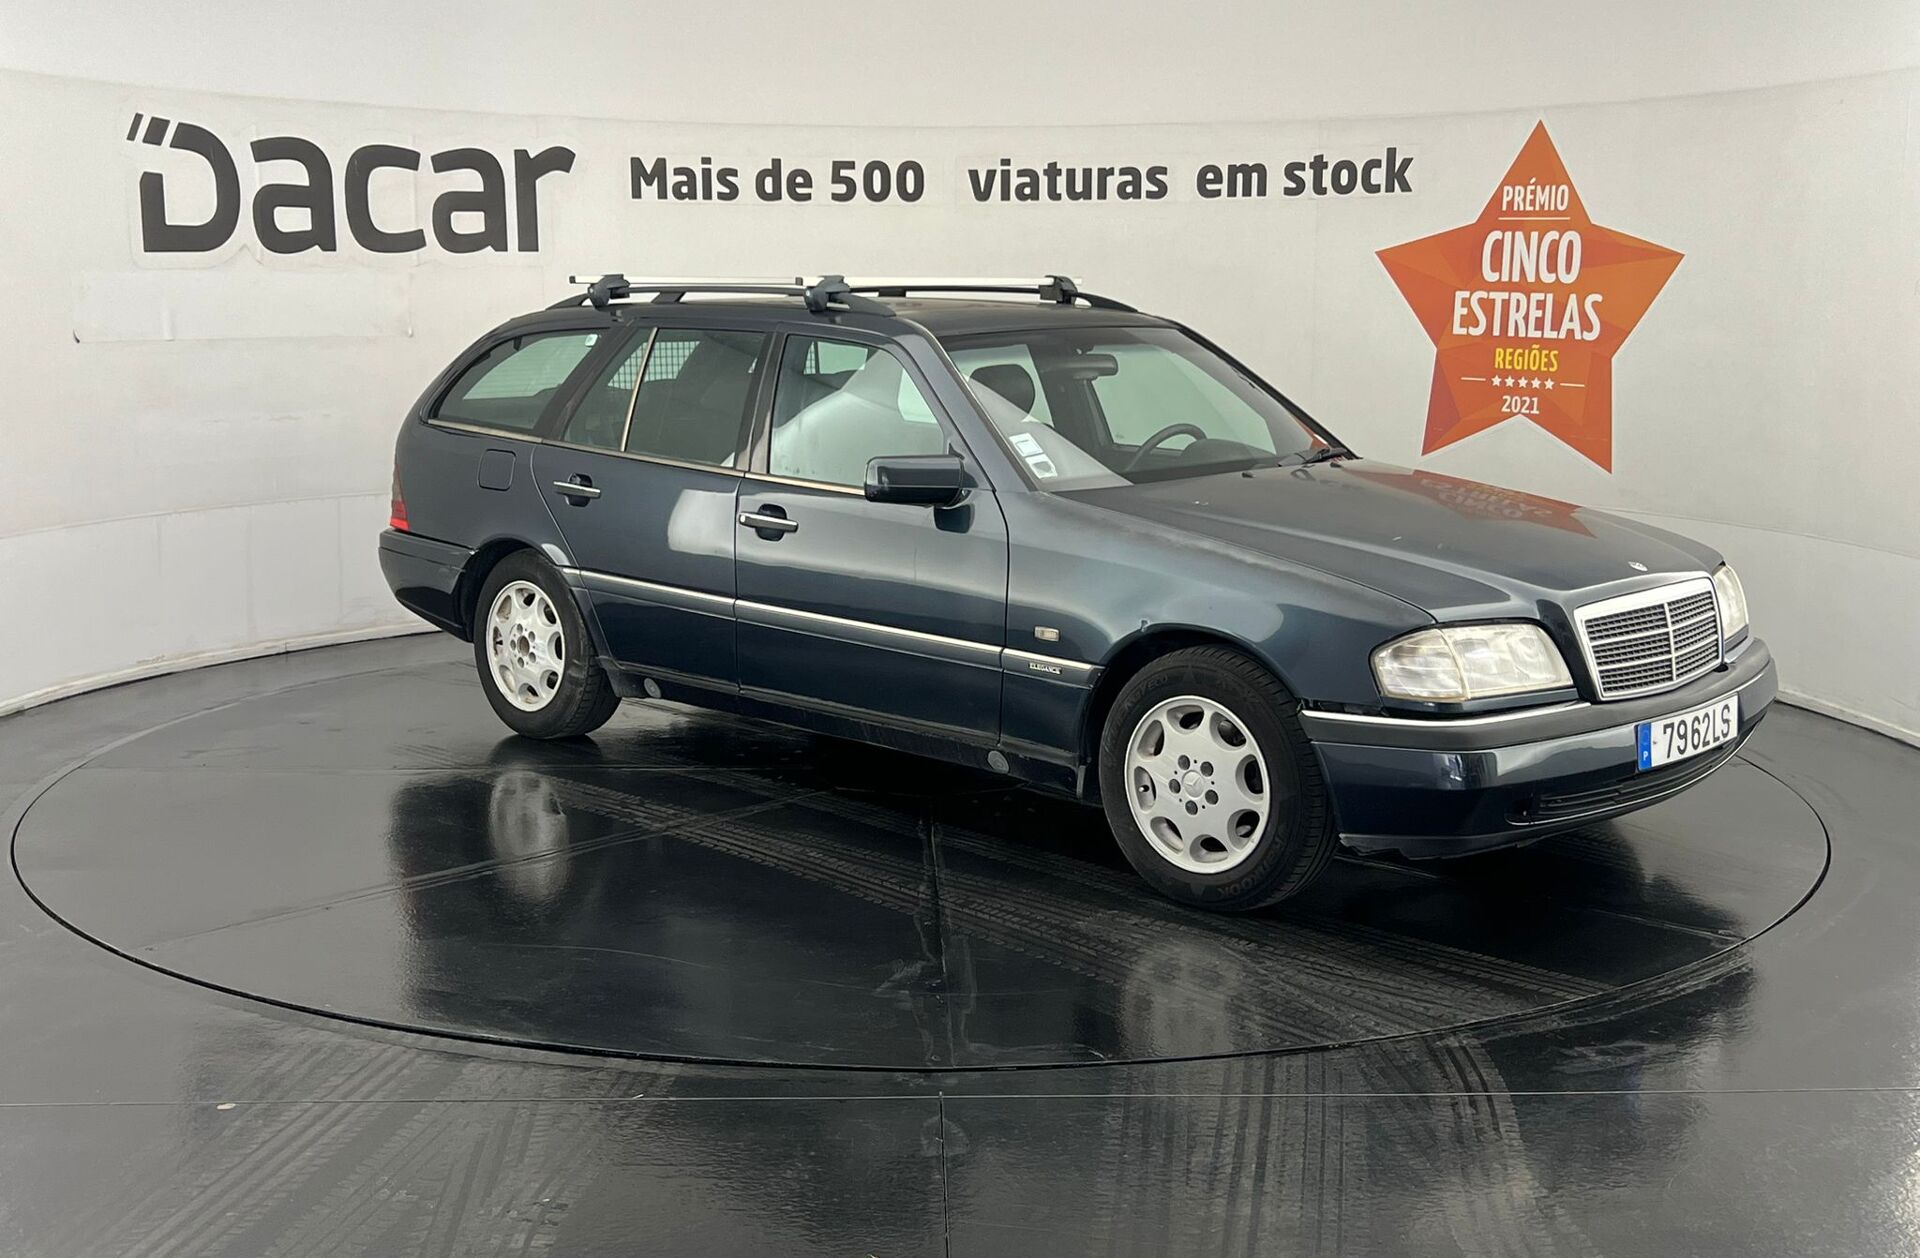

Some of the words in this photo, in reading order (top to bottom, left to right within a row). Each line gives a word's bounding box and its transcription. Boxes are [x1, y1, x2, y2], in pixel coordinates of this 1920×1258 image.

[127, 113, 575, 254] Dacar
[631, 157, 739, 201] Mais
[756, 159, 812, 201] de
[832, 161, 924, 202] 500
[968, 159, 1167, 201] viaturas
[1197, 163, 1267, 198] em
[1284, 148, 1413, 196] stock
[1501, 178, 1569, 211] PRÉMIO
[1482, 230, 1581, 284] CINCO
[1453, 291, 1602, 341] ESTRELAS
[1495, 344, 1558, 373] REGIÕES
[1501, 396, 1540, 415] 2021
[1643, 750, 1649, 760] P
[1663, 704, 1731, 759] 7962LS
